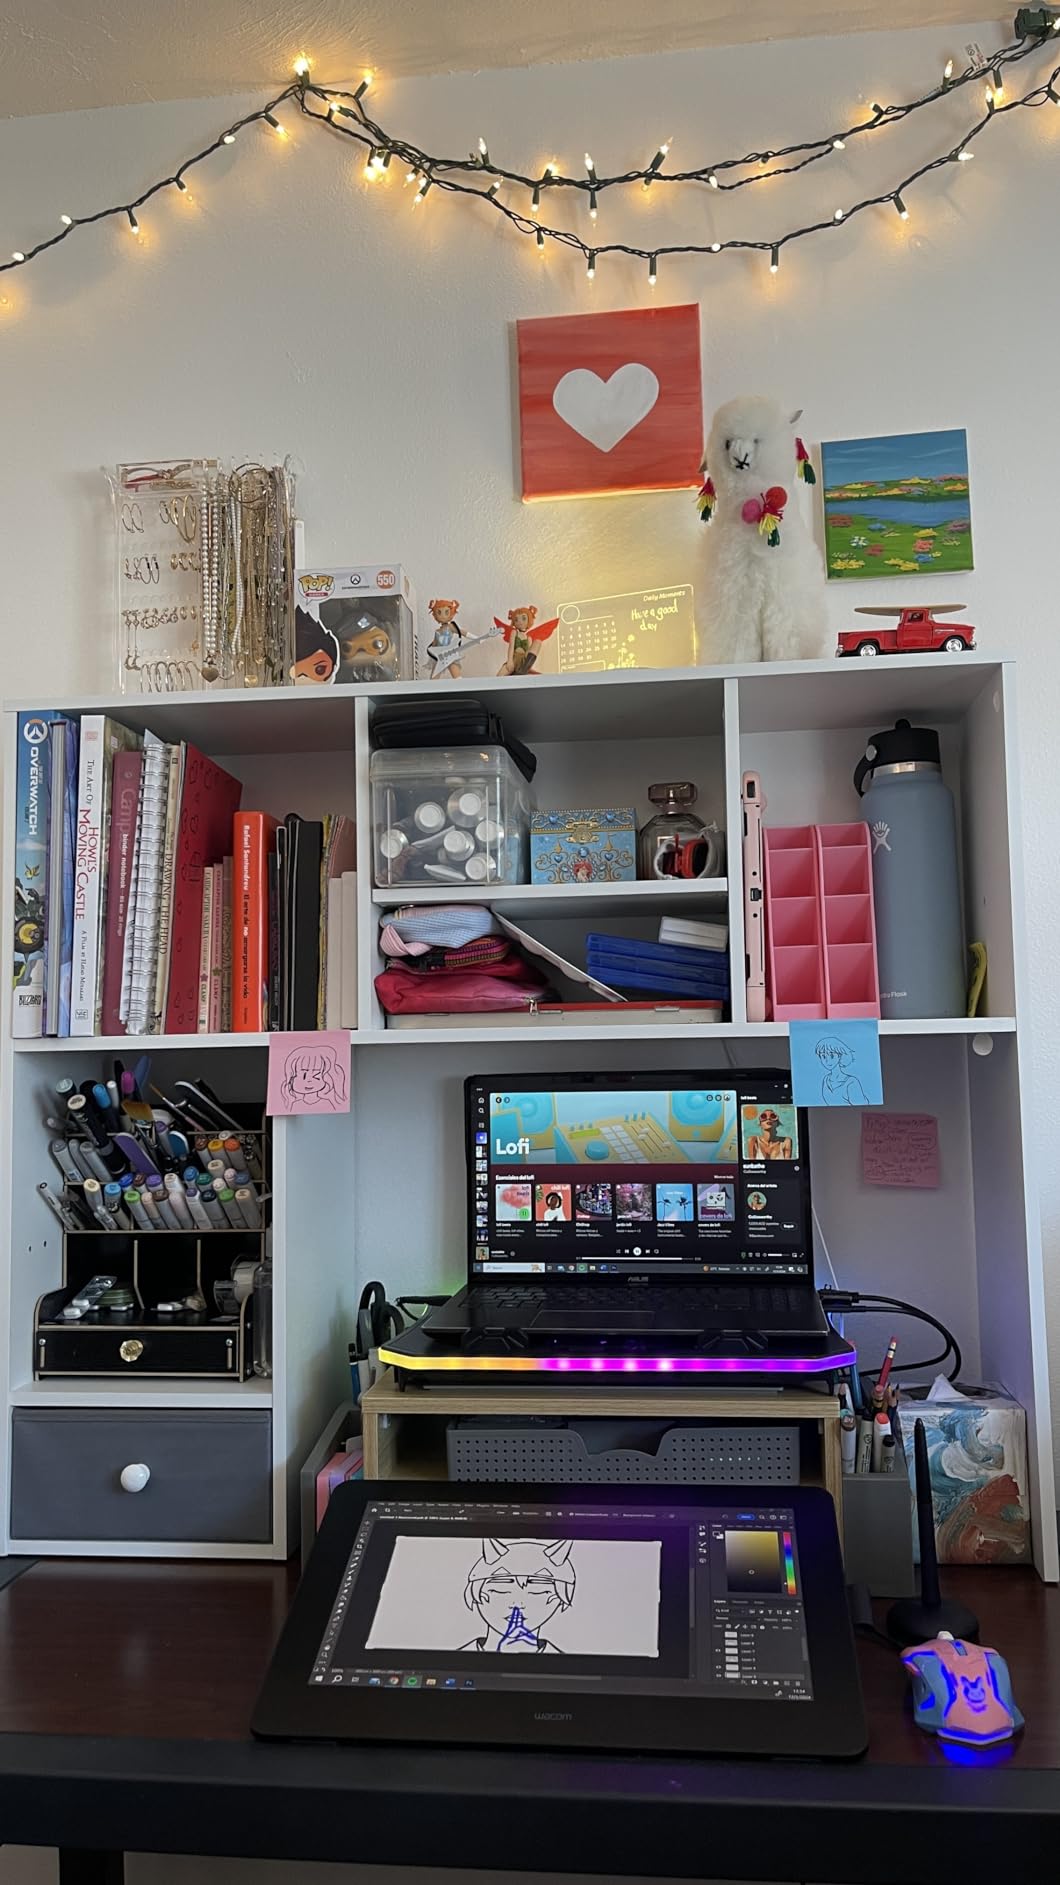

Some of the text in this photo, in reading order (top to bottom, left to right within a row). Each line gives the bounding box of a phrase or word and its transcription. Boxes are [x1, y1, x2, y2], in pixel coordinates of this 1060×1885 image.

[298, 575, 335, 592] POP!
[376, 574, 395, 586] 550
[643, 594, 659, 602] Daily
[656, 599, 679, 620] good
[639, 622, 658, 631] day
[87, 759, 95, 775] THE
[28, 746, 39, 836] OVERWATCH
[86, 794, 93, 805] OF
[87, 827, 99, 873] HOWL'S
[75, 809, 91, 920] MOVING CASTLE
[161, 853, 173, 900] DRAWING
[160, 905, 169, 921] THE
[243, 916, 249, 925] de
[243, 926, 248, 936] no
[159, 927, 169, 954] HEAD
[496, 1138, 530, 1155] Lofi
[534, 1711, 572, 1721] wacom
